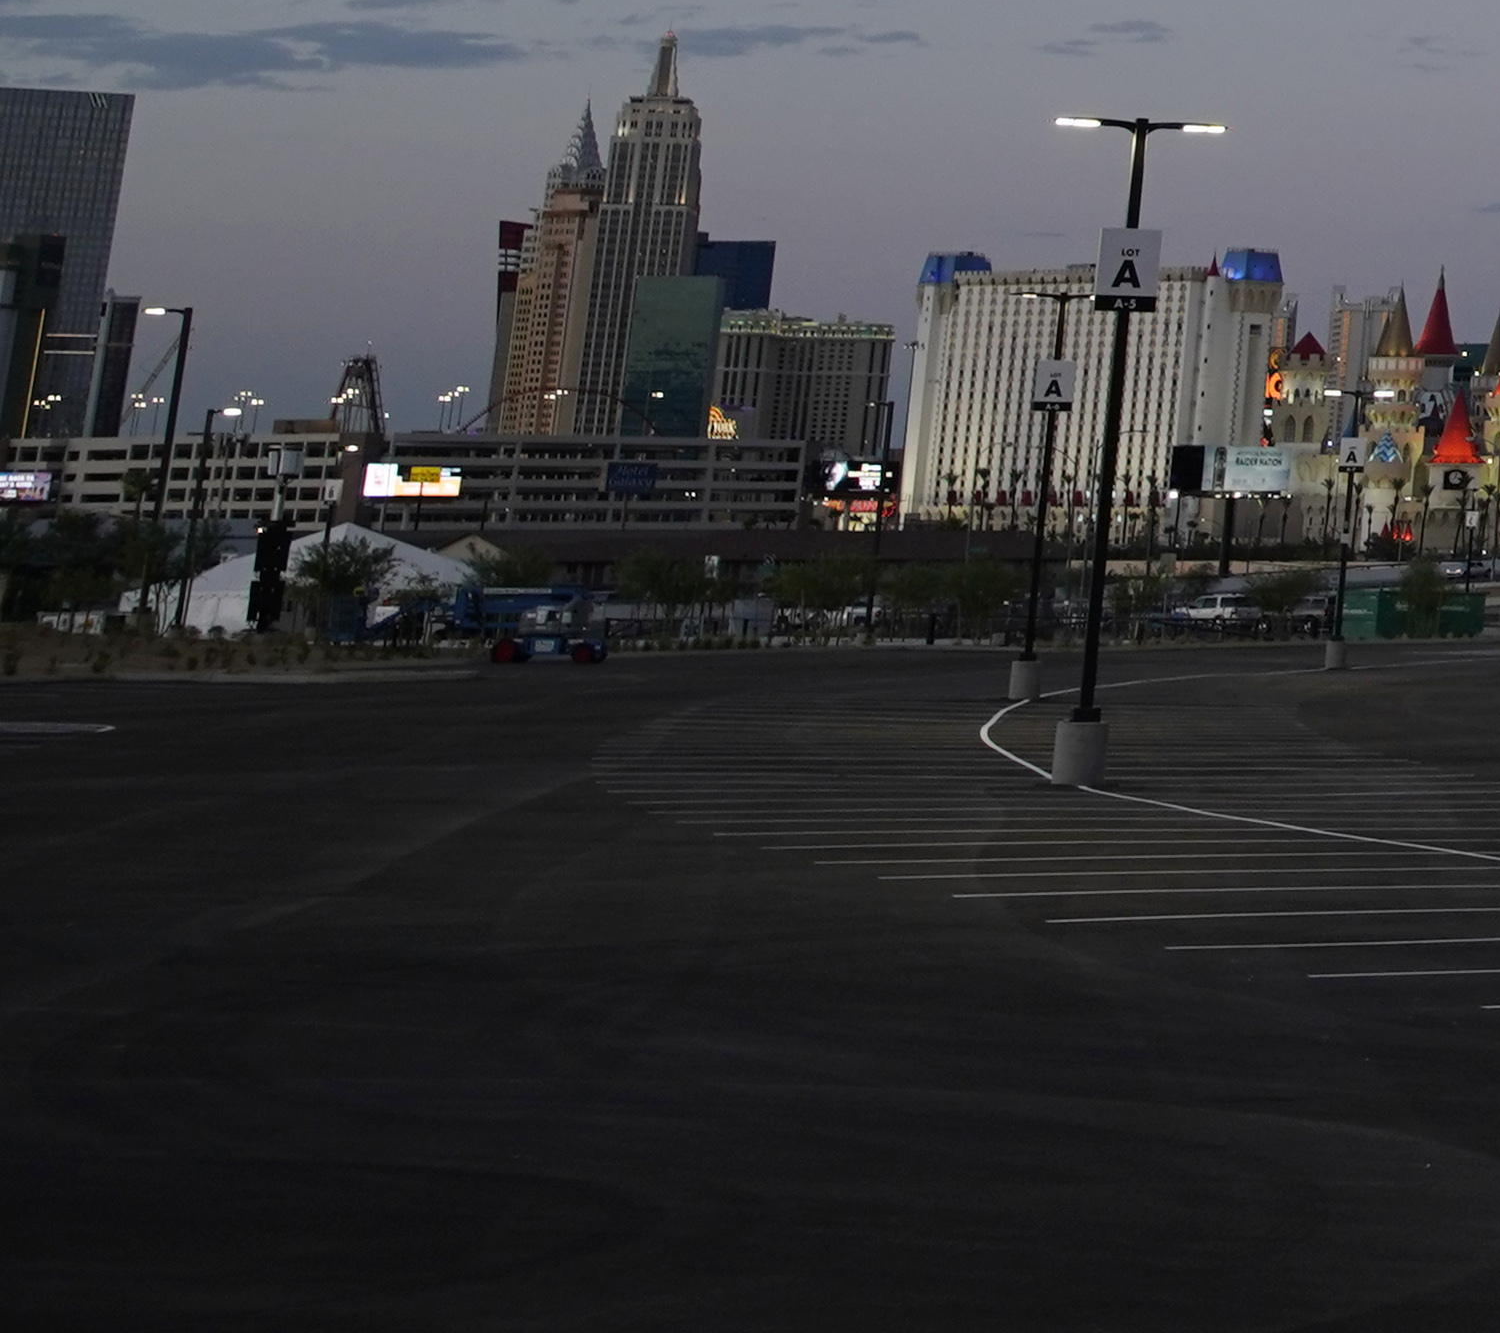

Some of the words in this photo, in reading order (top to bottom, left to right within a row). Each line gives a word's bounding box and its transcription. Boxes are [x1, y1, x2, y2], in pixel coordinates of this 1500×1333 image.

[1121, 248, 1141, 257] LOT
[1111, 259, 1141, 288] A
[1113, 298, 1138, 310] A-5
[1044, 379, 1062, 397] A
[1345, 450, 1357, 463] A
